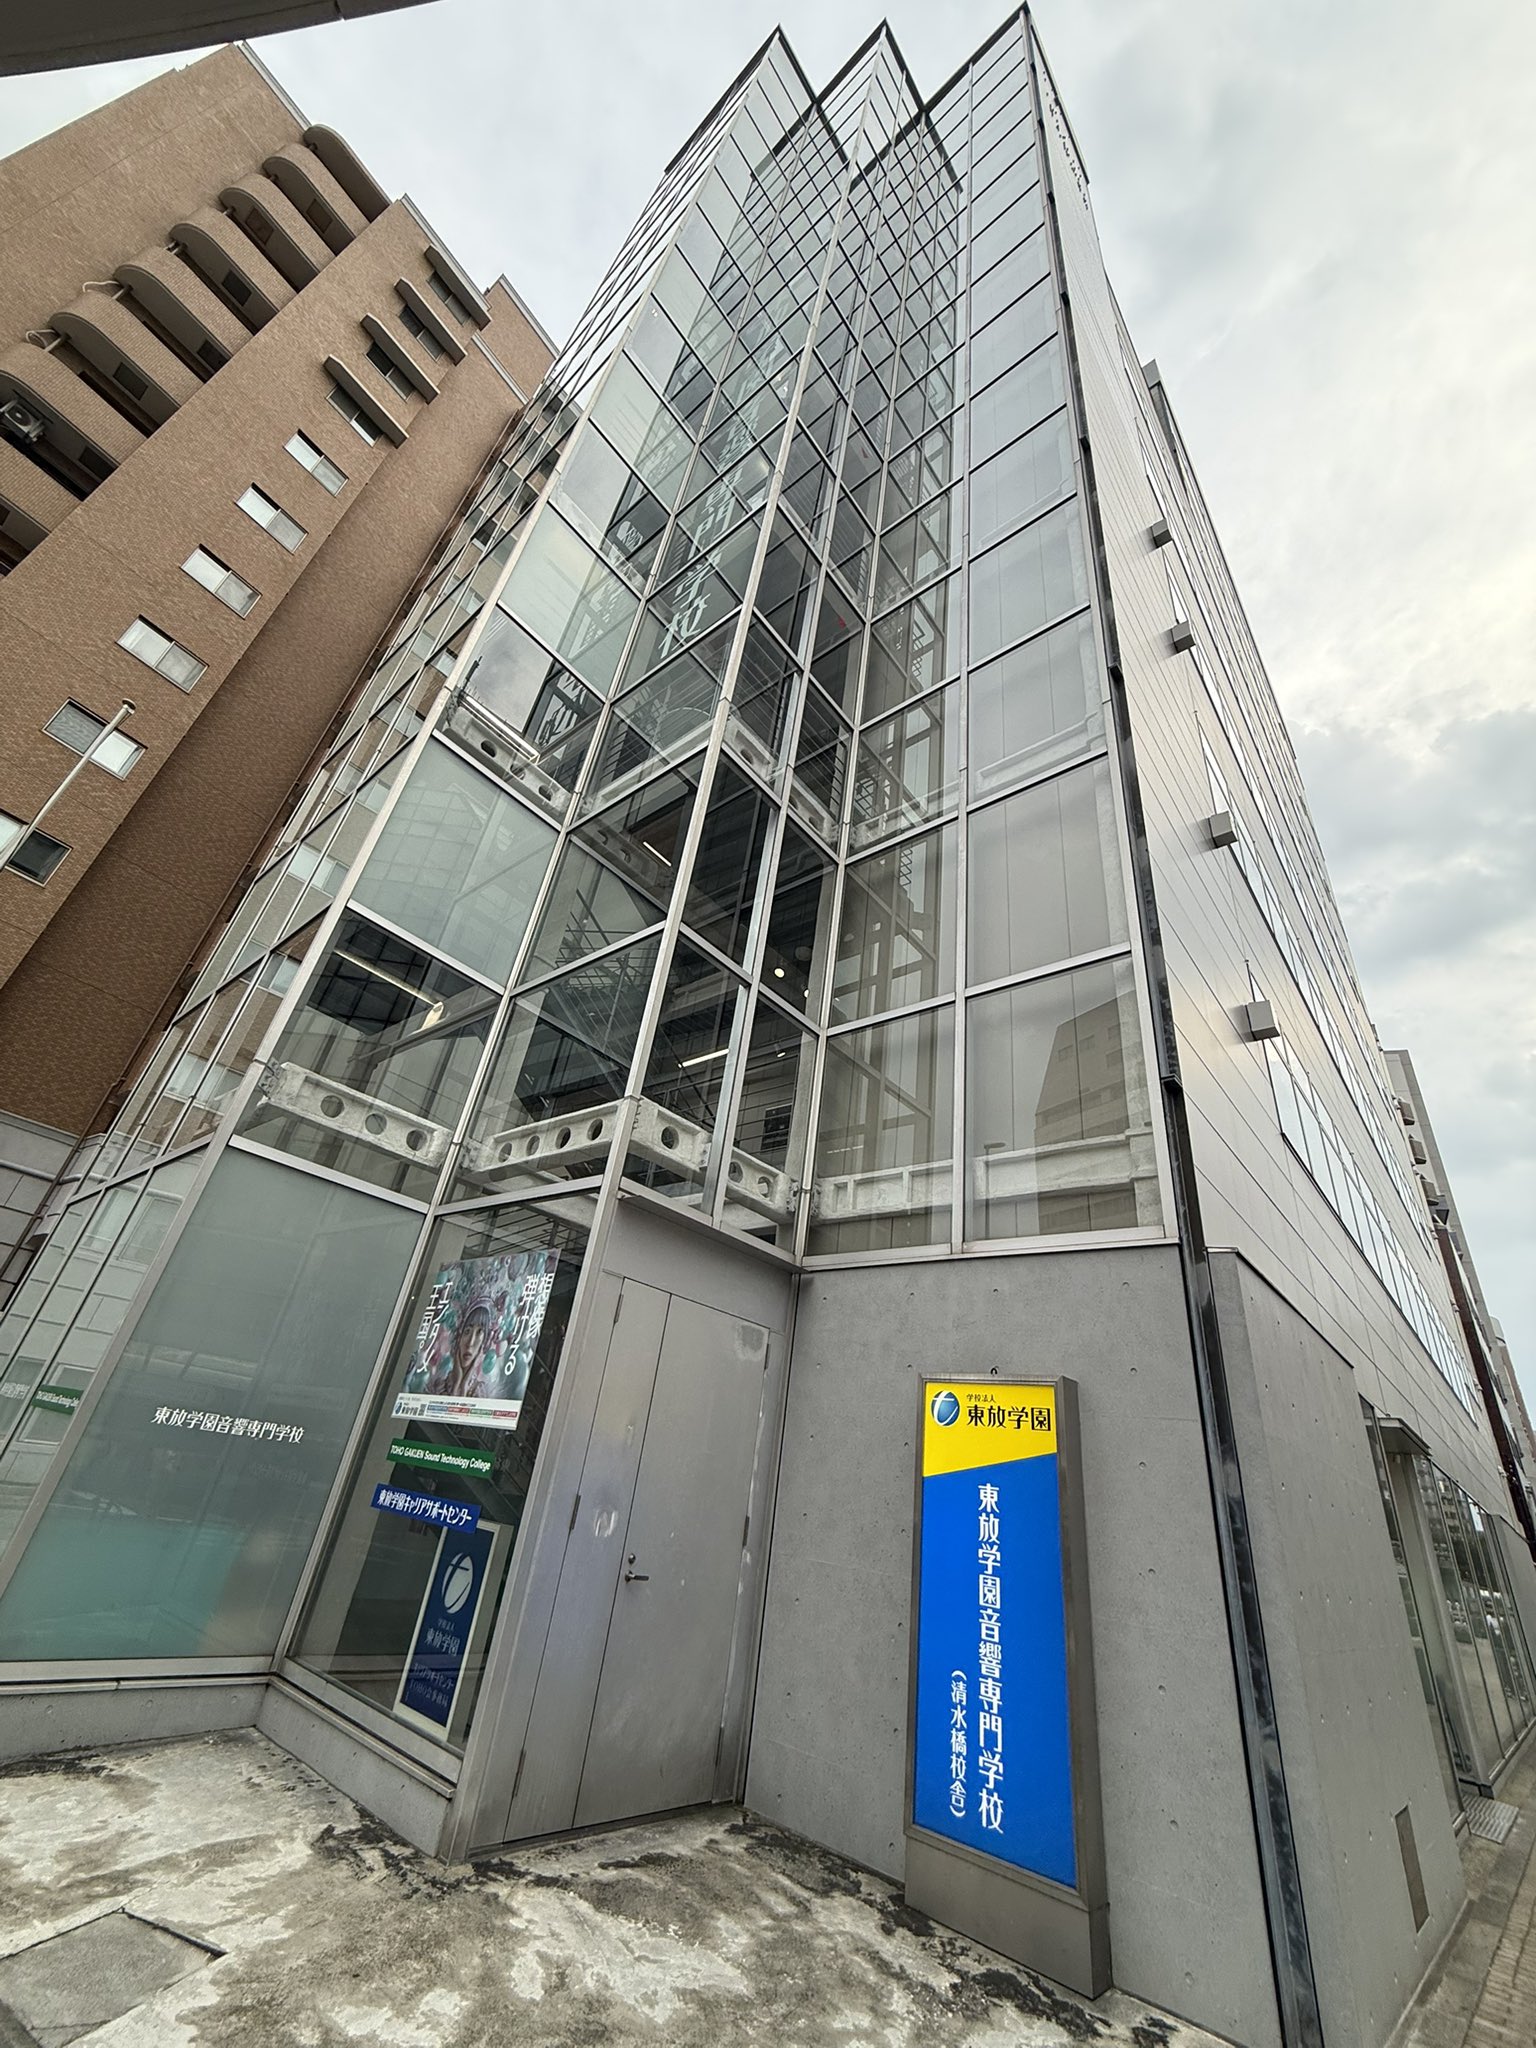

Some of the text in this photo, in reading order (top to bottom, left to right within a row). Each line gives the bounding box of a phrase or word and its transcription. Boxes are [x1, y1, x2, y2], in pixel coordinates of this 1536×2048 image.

[417, 1281, 454, 1373] エンタメ
[966, 1393, 997, 1404] 学校法人
[151, 1406, 305, 1444] 東放学園音響専門学校
[966, 1404, 1052, 1432] 東放学園
[390, 1445, 492, 1473] TOHO GAKUEN Sound Technology College
[377, 1489, 473, 1526] 東放学園キャリアサポートセンター
[424, 1627, 461, 1657] 東放学園
[977, 1483, 1004, 1834] 東放学園音響専門学校
[949, 1670, 968, 1818] （清水橋校舎）
